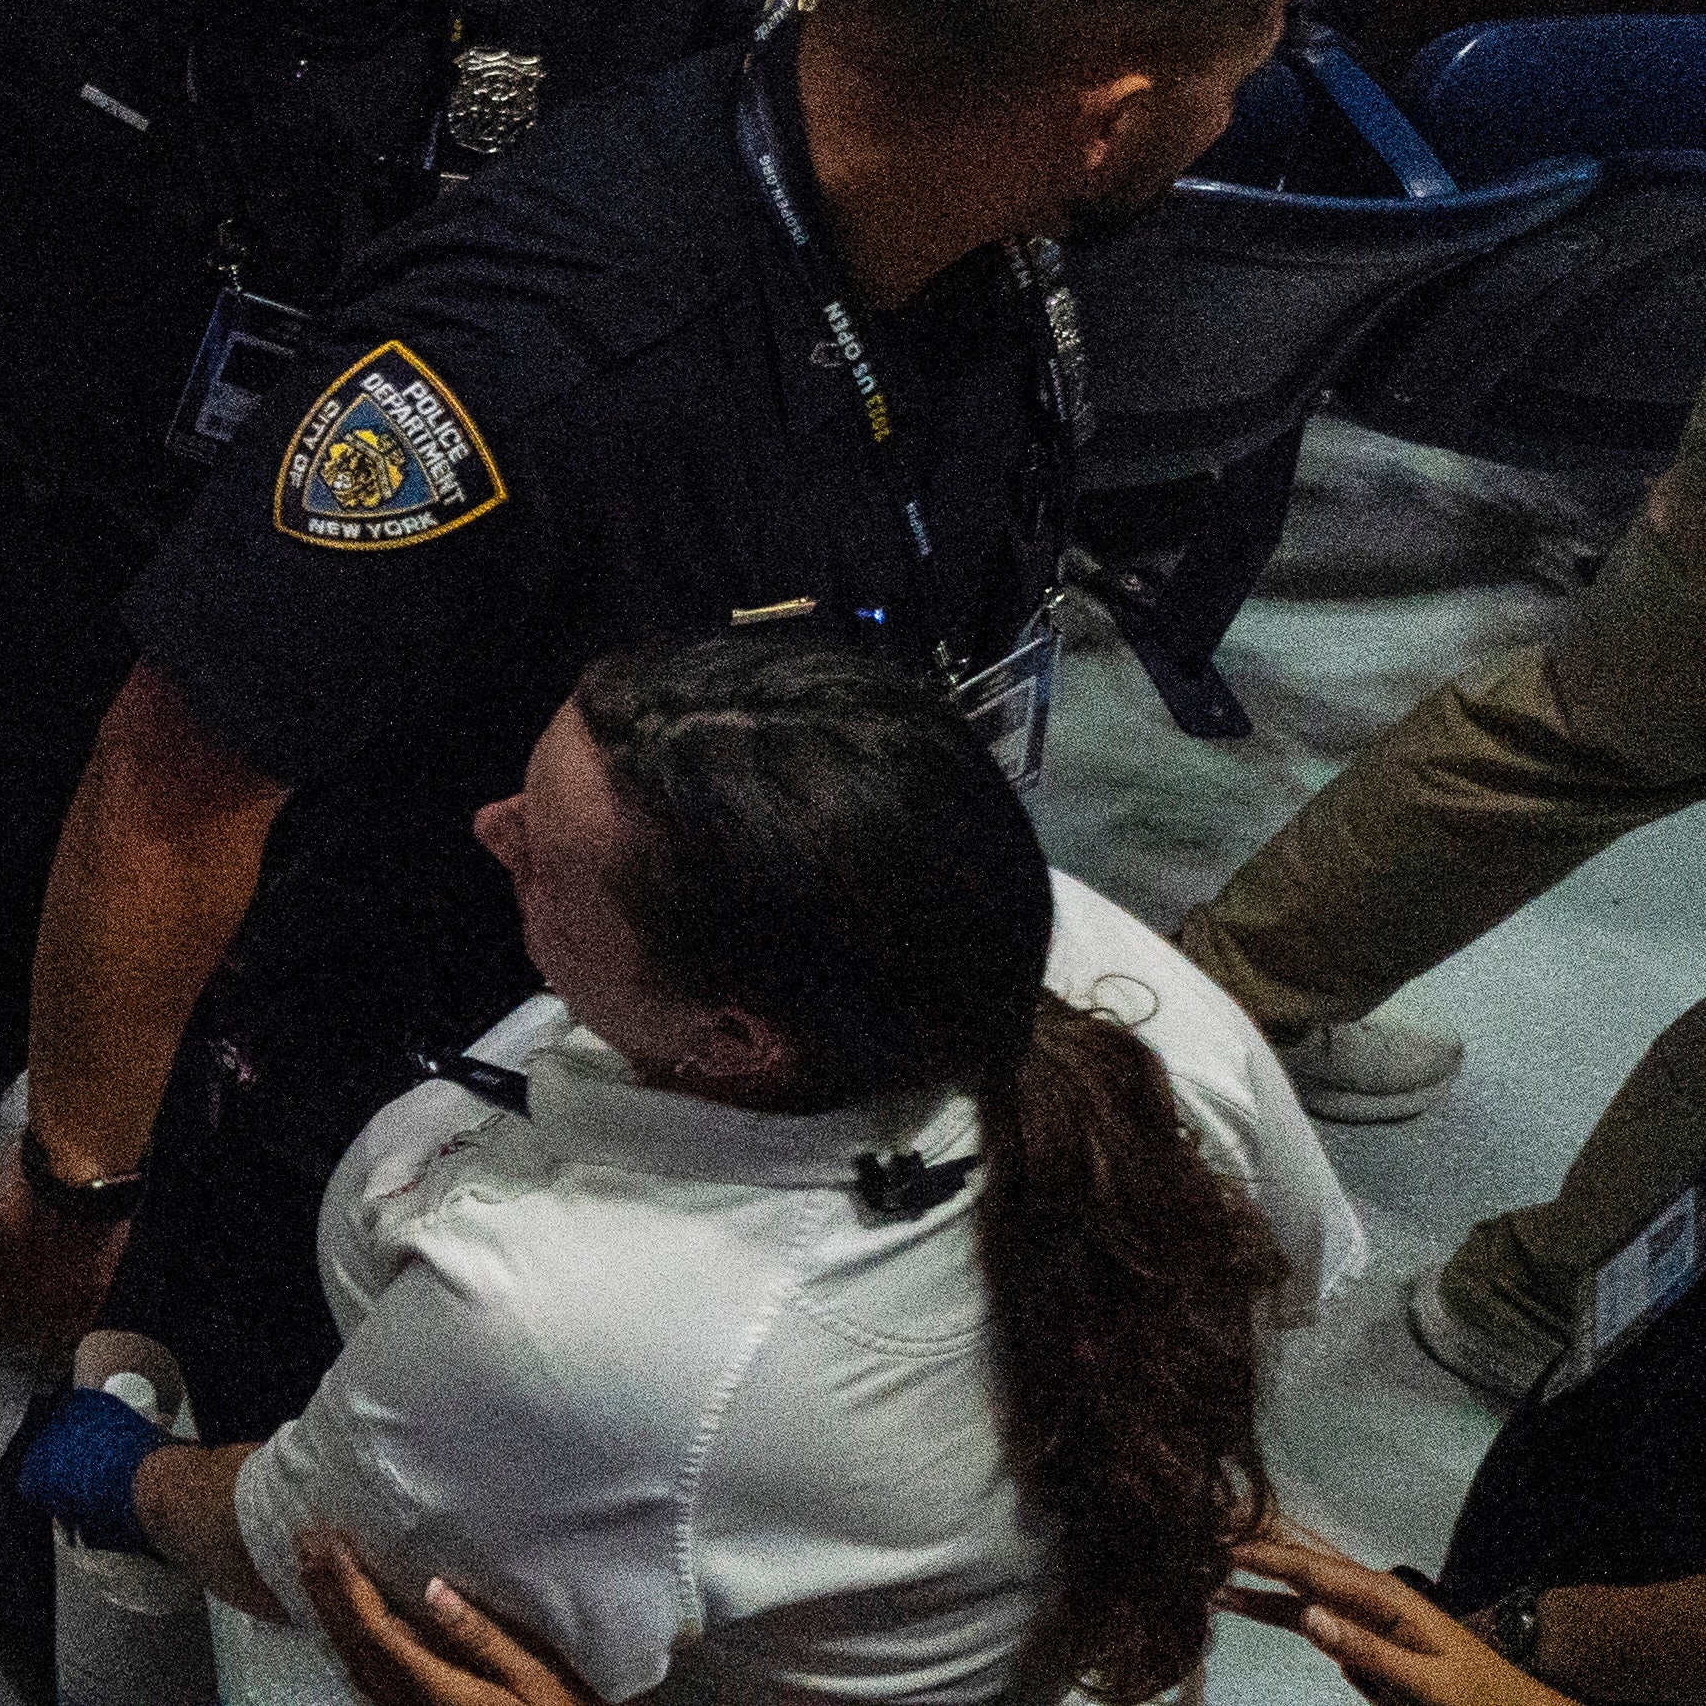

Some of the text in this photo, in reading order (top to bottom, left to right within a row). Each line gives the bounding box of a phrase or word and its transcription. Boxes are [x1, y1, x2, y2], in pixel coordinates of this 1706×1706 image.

[823, 300, 863, 362] OPEN
[851, 361, 877, 395] US
[288, 399, 341, 488] CITY OF
[360, 371, 467, 507] DEPARTMENT
[400, 379, 470, 464] POLICE
[307, 510, 440, 539] NEW YORK
